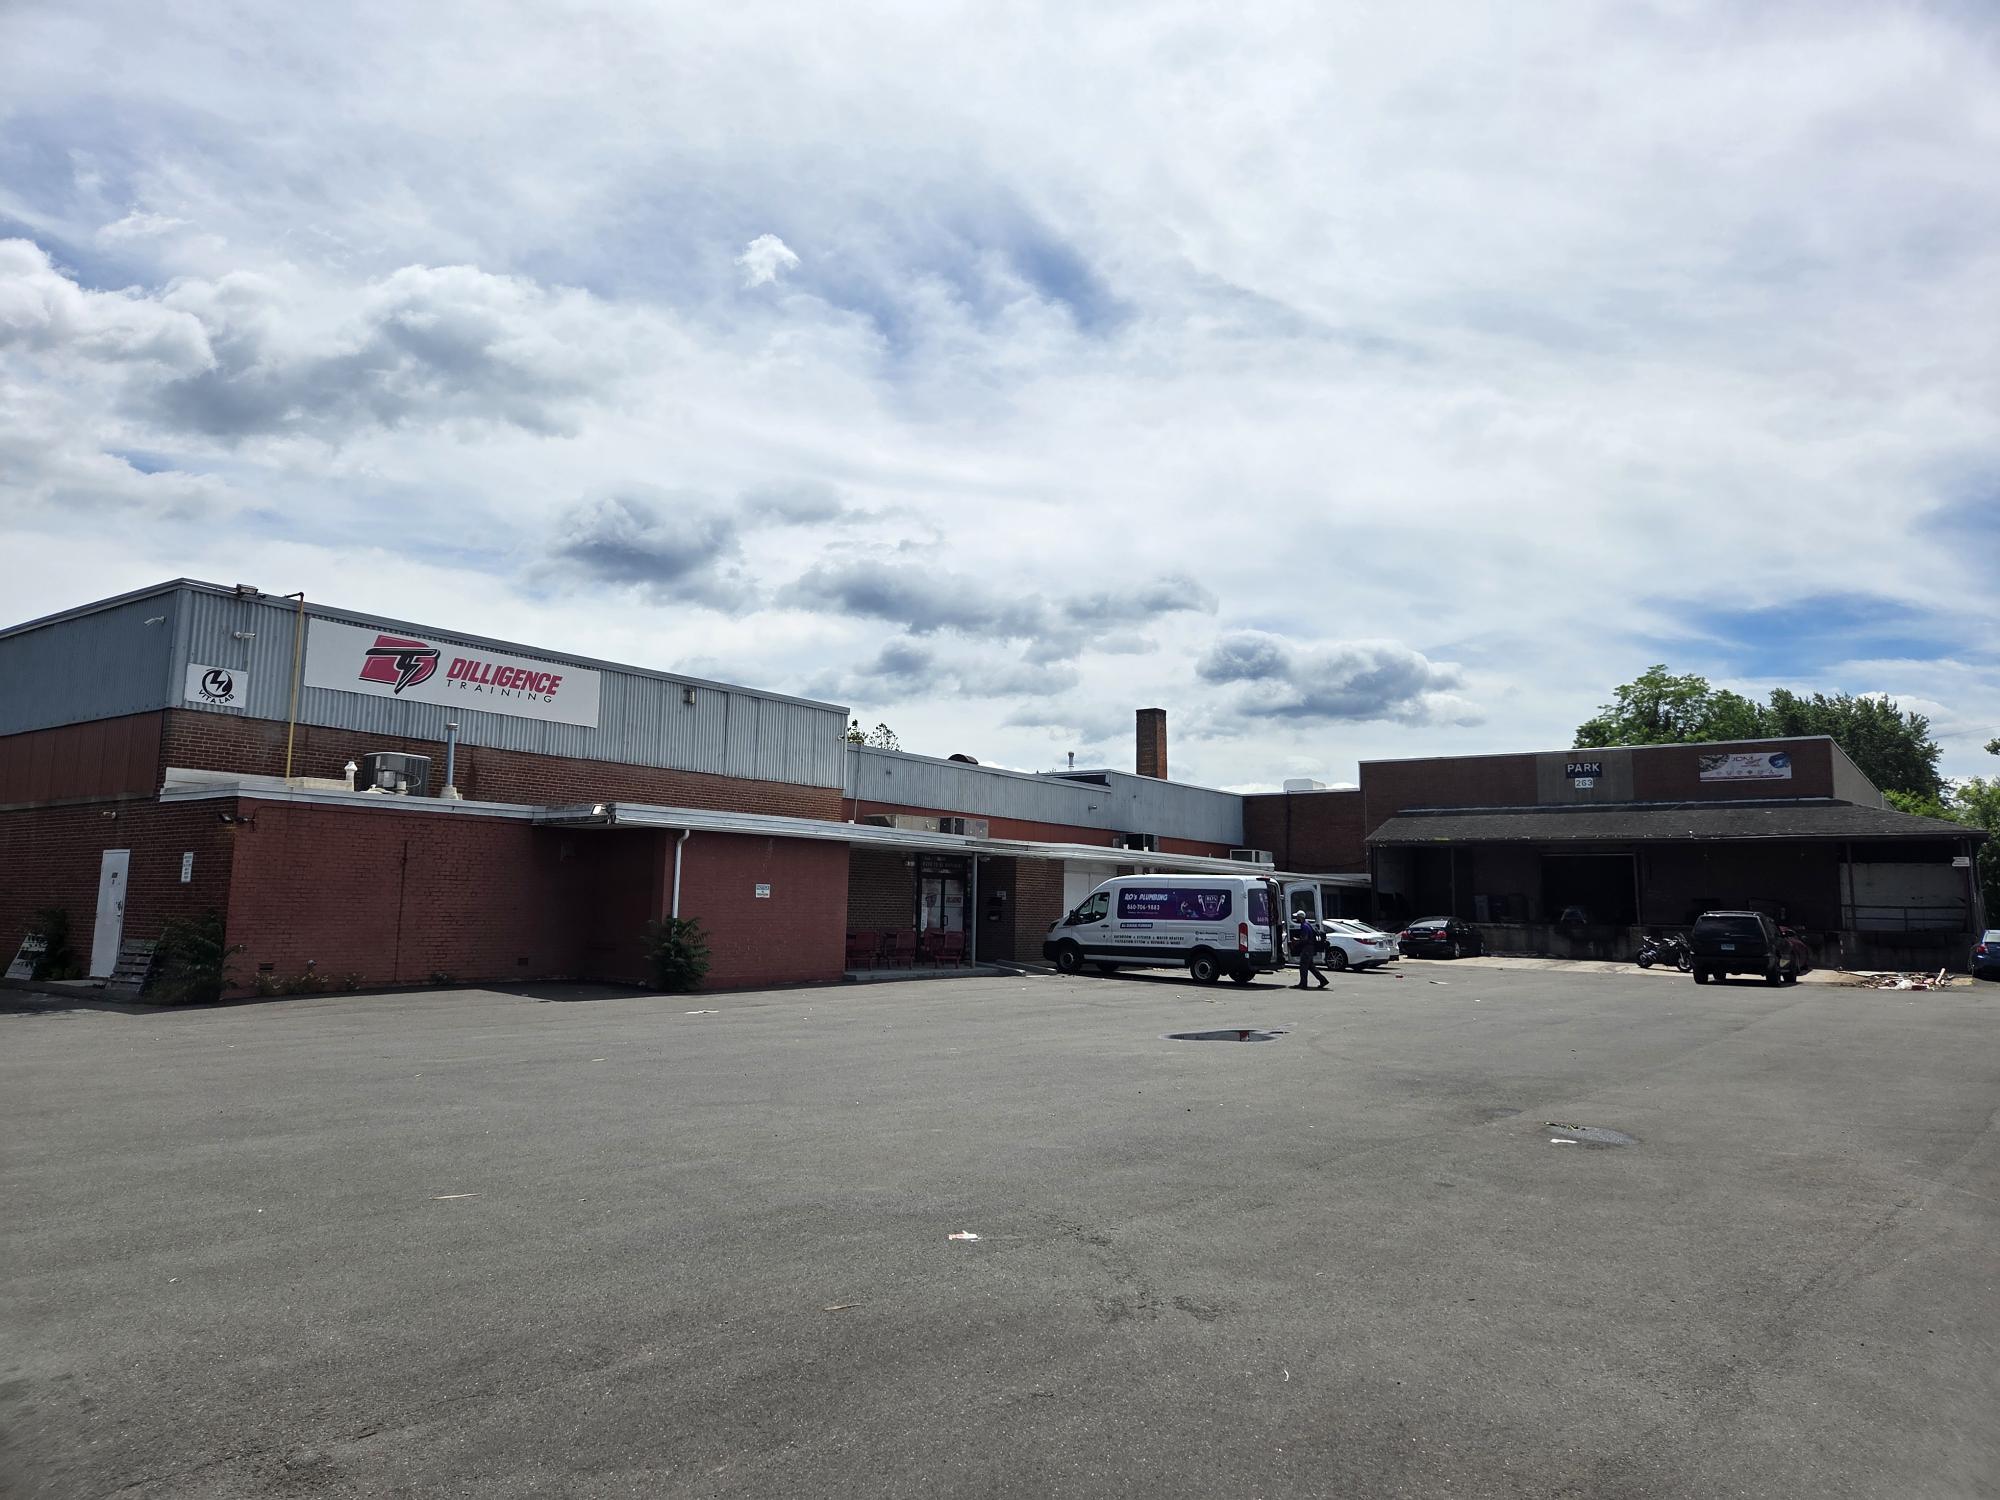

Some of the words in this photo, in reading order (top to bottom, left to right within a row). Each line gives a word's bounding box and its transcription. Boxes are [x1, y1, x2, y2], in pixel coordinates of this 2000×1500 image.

[447, 658, 563, 695] DILLIGENCE
[447, 680, 552, 703] TRAINING
[1567, 763, 1600, 773] PARK
[1576, 779, 1593, 787] 263
[1139, 893, 1168, 901] PLUMBING
